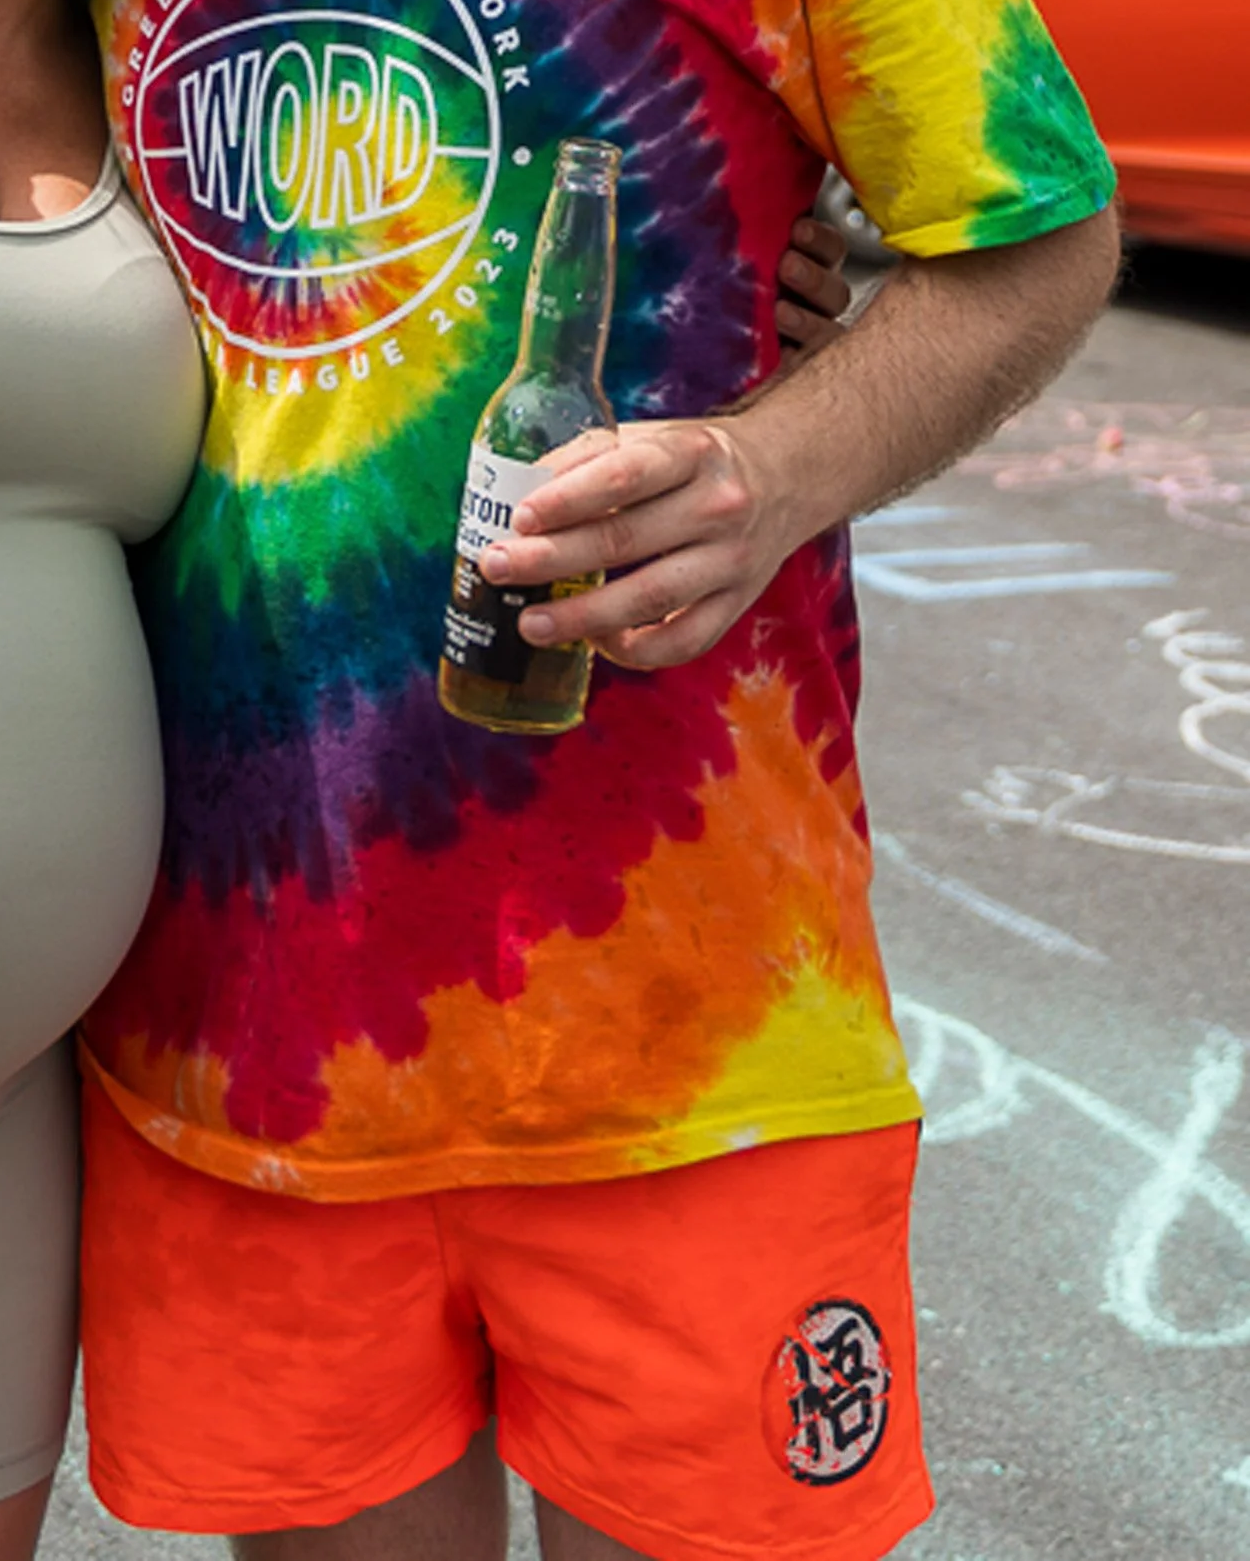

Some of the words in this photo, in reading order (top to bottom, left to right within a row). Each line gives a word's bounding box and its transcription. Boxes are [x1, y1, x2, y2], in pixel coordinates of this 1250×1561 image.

[179, 42, 438, 232] WORD
[245, 338, 403, 396] LEAGUE
[428, 231, 520, 333] 2023
